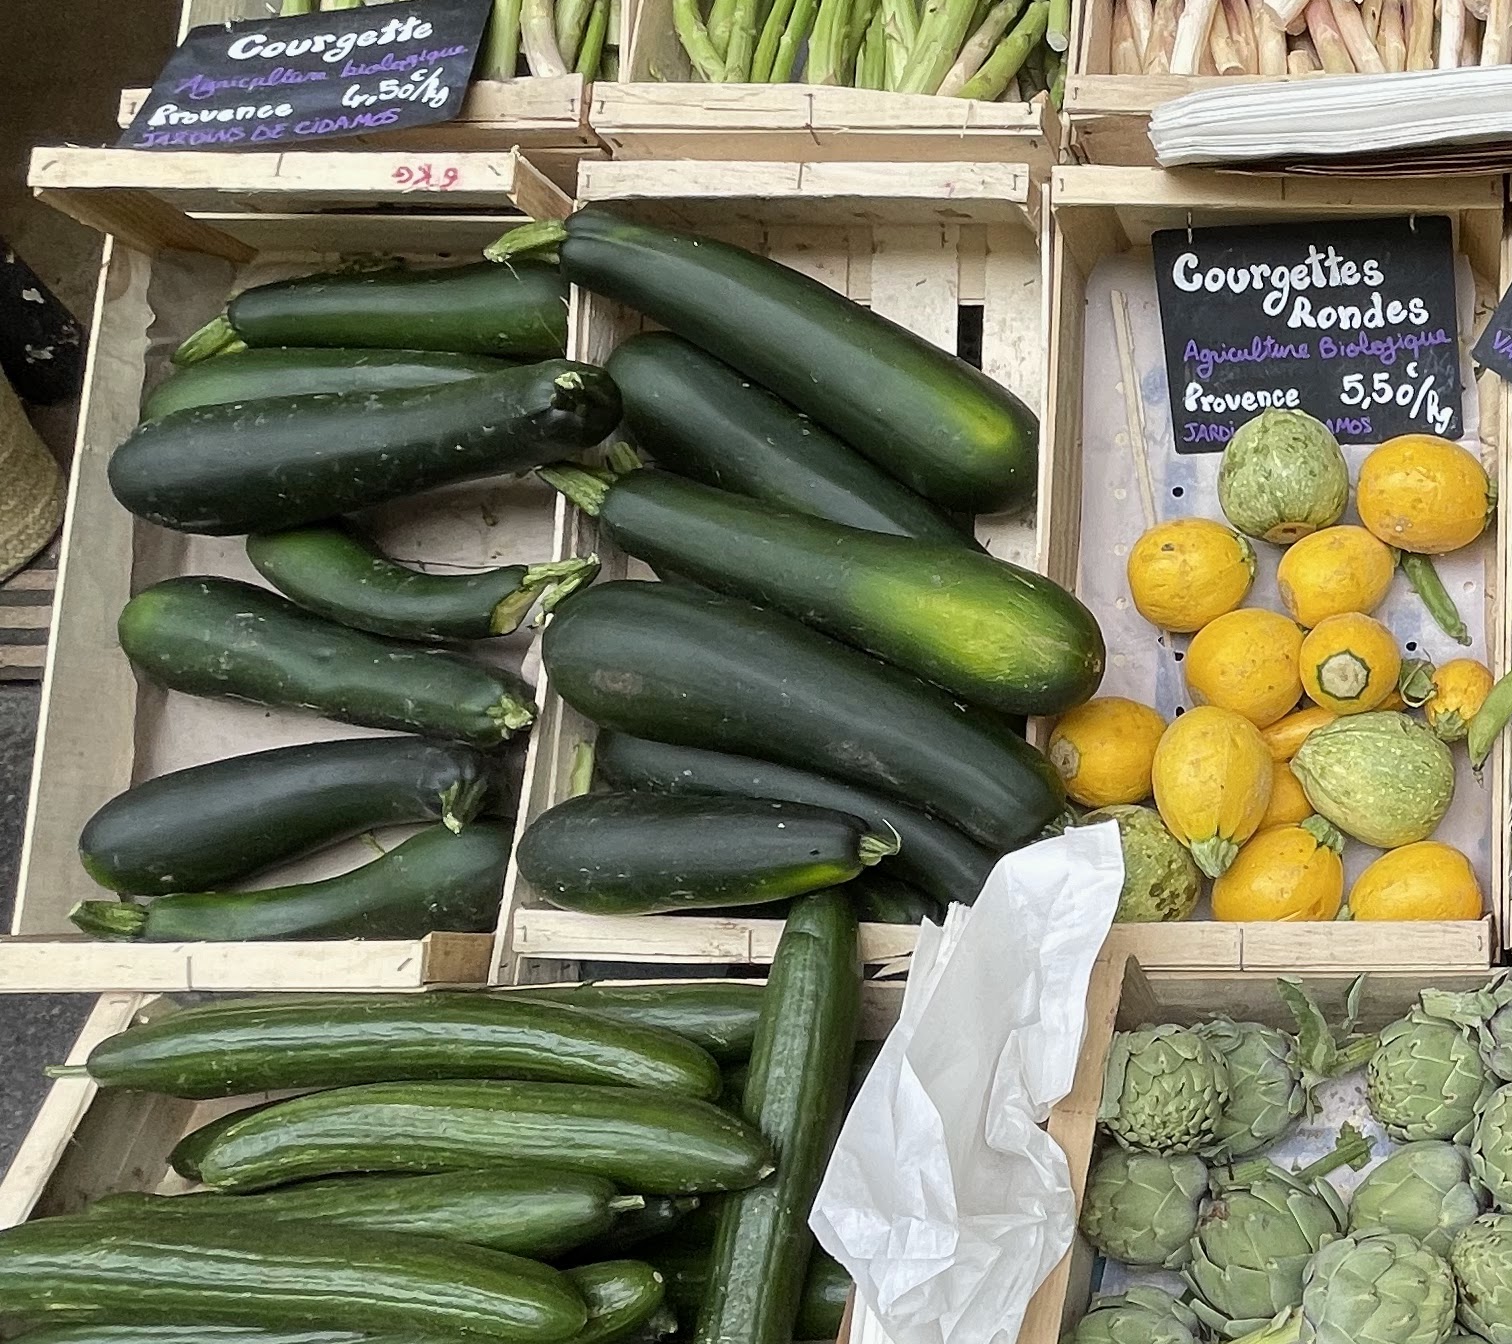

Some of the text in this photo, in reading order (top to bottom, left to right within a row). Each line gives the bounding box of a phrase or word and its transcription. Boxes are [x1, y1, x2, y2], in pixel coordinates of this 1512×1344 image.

[227, 15, 433, 63] Courgette
[147, 102, 293, 128] Provence
[250, 123, 283, 141] DE
[1173, 244, 1384, 317] Courgettes
[1287, 292, 1429, 330] Rondes
[1183, 328, 1452, 379] Agriculture Biologique
[1184, 381, 1300, 413] Provence
